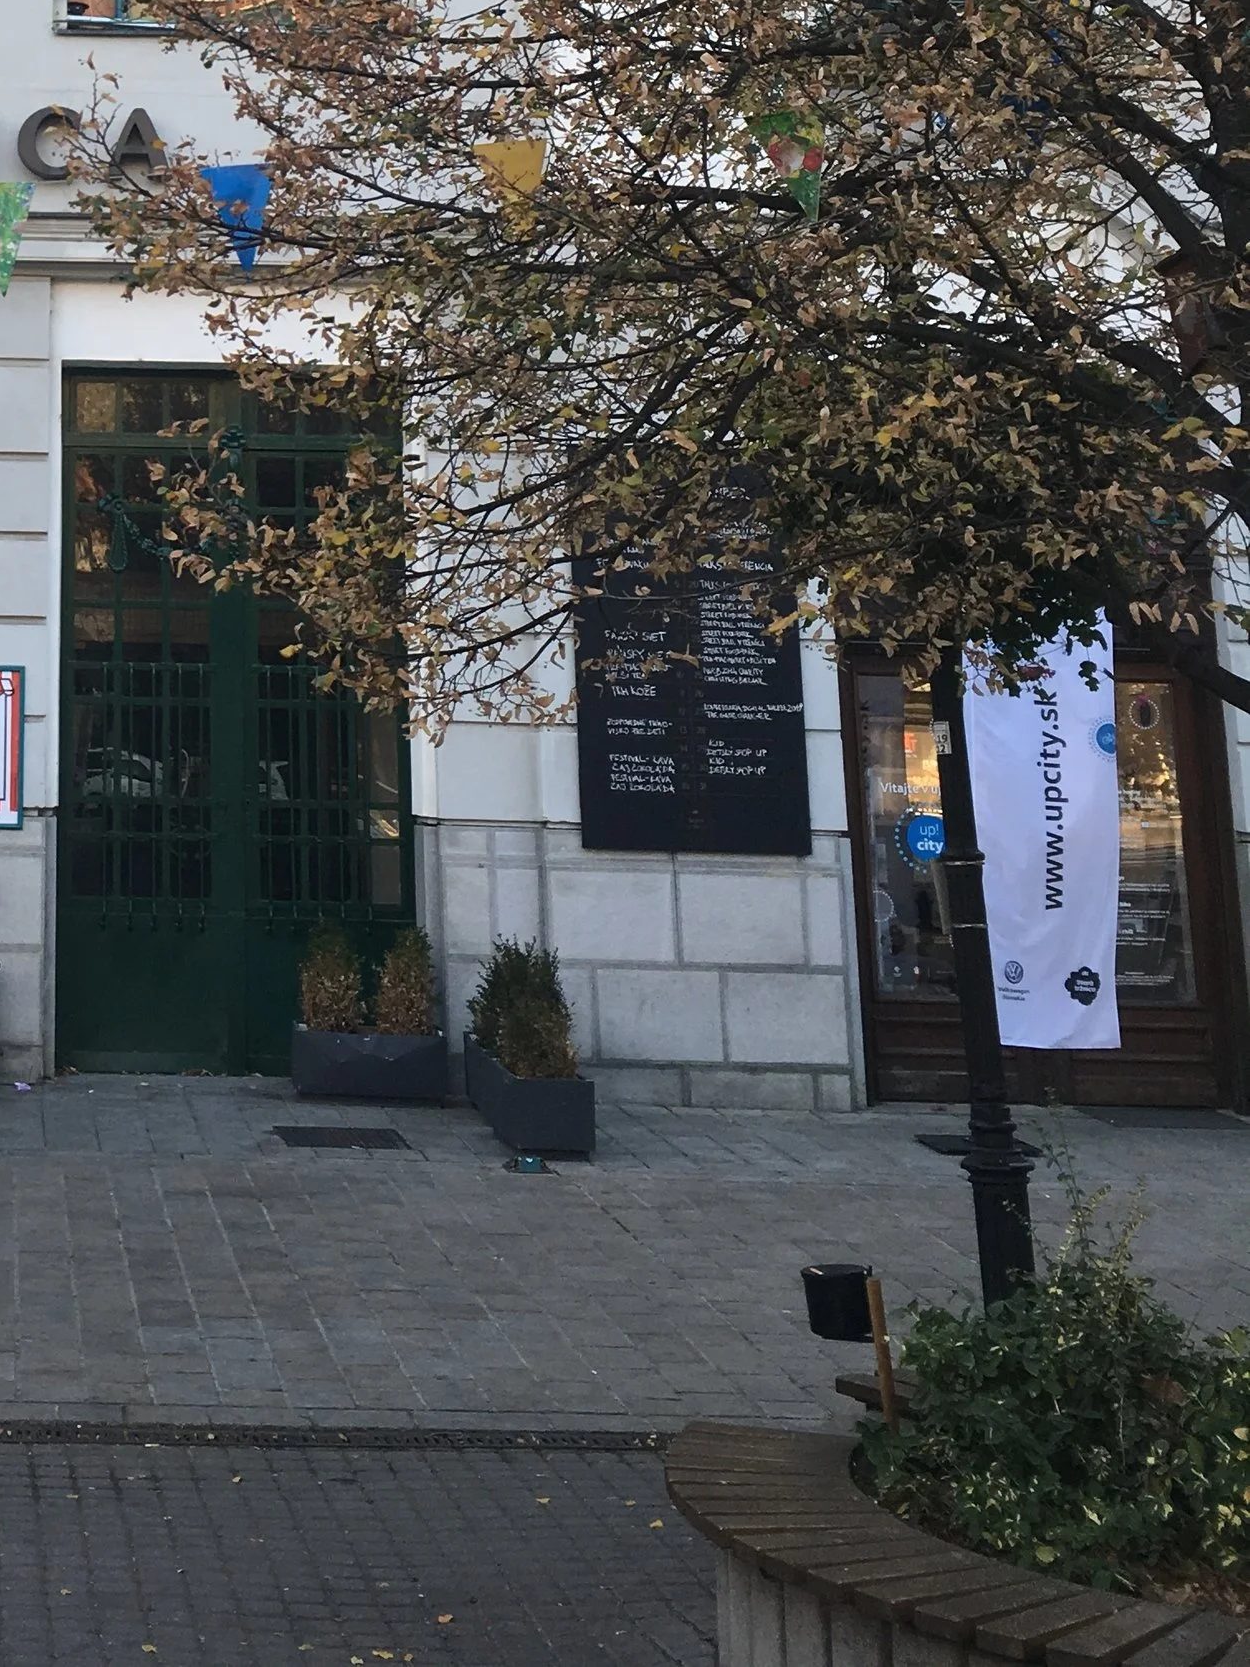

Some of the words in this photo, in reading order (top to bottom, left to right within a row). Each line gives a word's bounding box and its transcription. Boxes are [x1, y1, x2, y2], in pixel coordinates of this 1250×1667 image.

[630, 684, 656, 697] KOŽE
[880, 782, 919, 796] Vitajte
[1034, 690, 1068, 911] www.upcity.sk
[920, 824, 939, 838] up!
[917, 838, 944, 854] city
